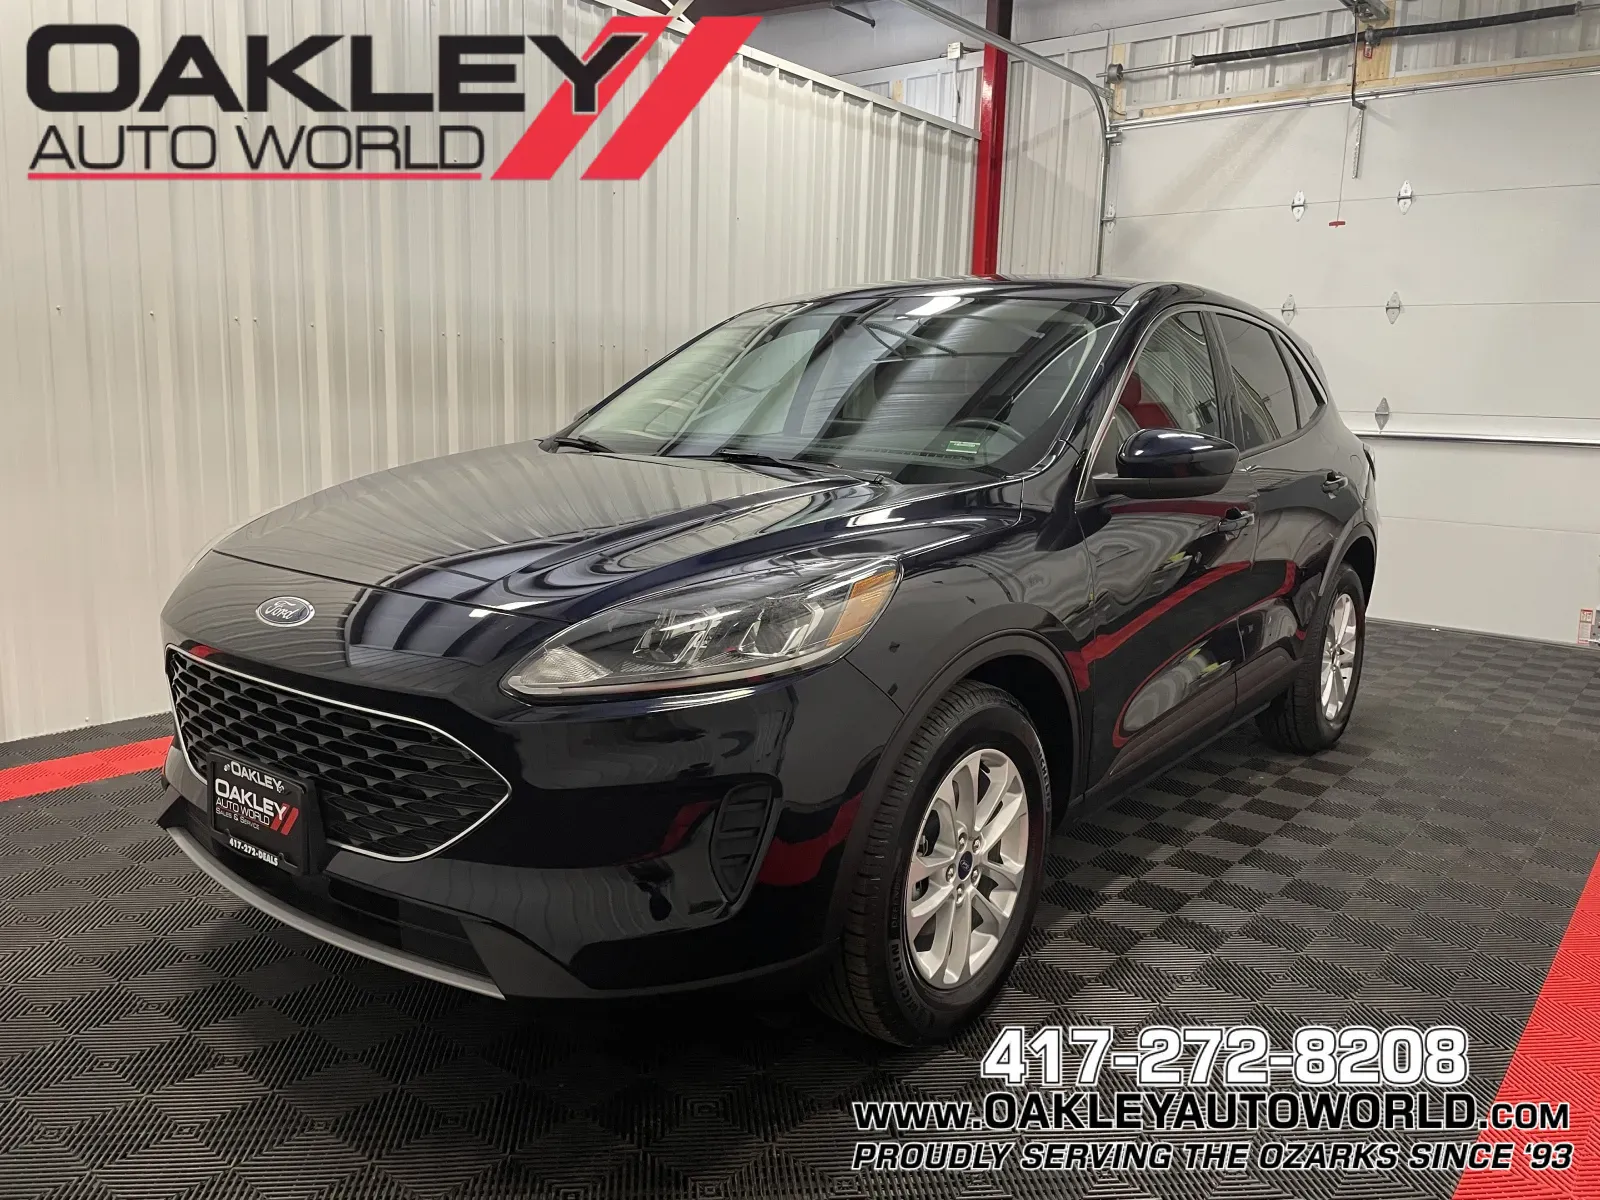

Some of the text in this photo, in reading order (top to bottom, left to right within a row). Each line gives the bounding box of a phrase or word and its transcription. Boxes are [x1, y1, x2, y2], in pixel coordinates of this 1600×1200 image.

[265, 600, 299, 619] Ford
[230, 760, 282, 792] OAKLEY
[215, 778, 287, 820] OAKLEY
[215, 797, 270, 826] AUTO WORLD
[229, 838, 278, 866] 417-272-DEALS
